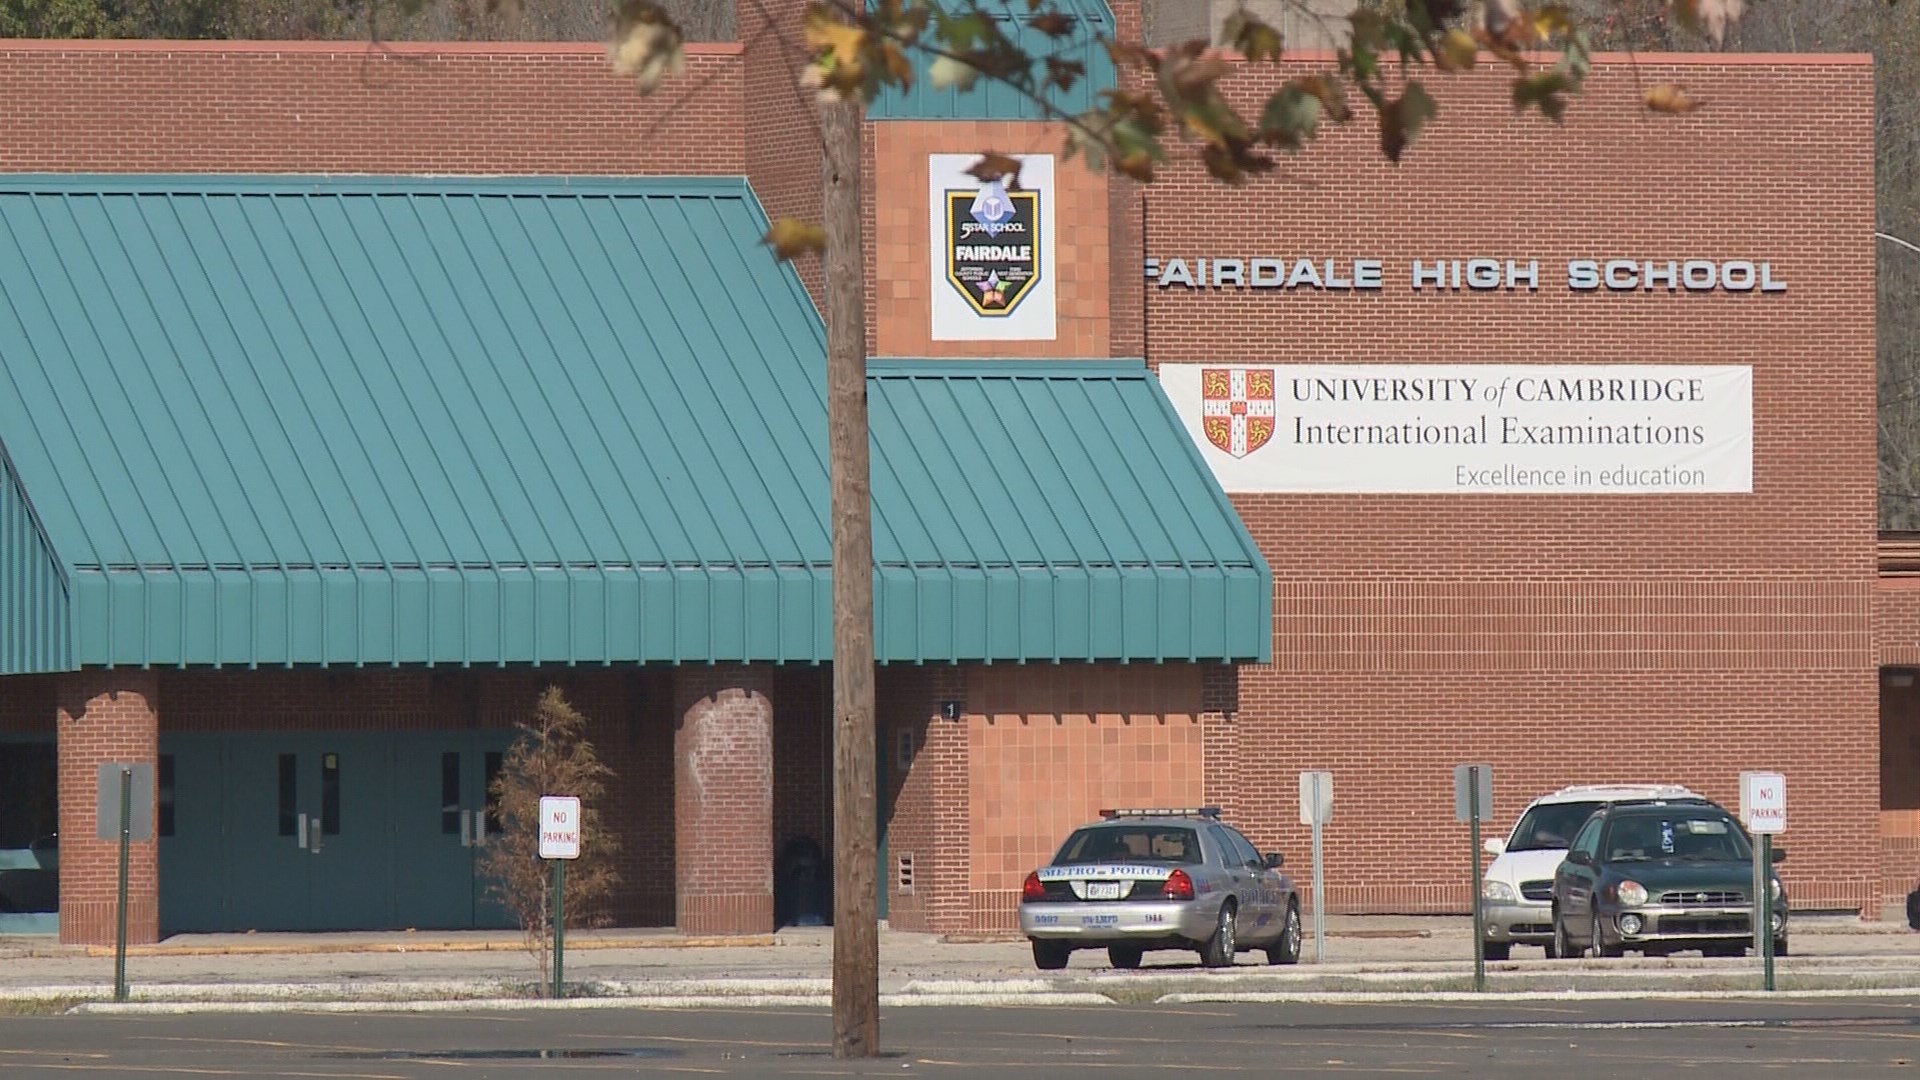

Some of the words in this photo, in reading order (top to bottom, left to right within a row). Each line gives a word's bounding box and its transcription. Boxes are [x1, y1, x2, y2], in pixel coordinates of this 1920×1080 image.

[990, 223, 1026, 232] SCHOOL
[955, 246, 1031, 261] FAIRDALE
[1412, 259, 1538, 289] HIGH
[1568, 260, 1787, 290] SCHOOL
[1292, 378, 1477, 402] UNIVERSITY
[1484, 377, 1510, 408] of
[1516, 378, 1705, 402] CAMBRIDGE
[1293, 416, 1488, 445] International
[1500, 416, 1705, 445] Examinations
[1456, 464, 1566, 487] Excellence
[1574, 465, 1592, 485] in
[1600, 464, 1705, 486] education
[946, 703, 954, 718] 1
[1760, 788, 1773, 799] NO
[553, 812, 567, 823] NO
[1751, 808, 1783, 818] PARKING
[543, 832, 576, 843] PARKING
[1043, 867, 1096, 878] METRO
[1111, 867, 1167, 877] POLICE
